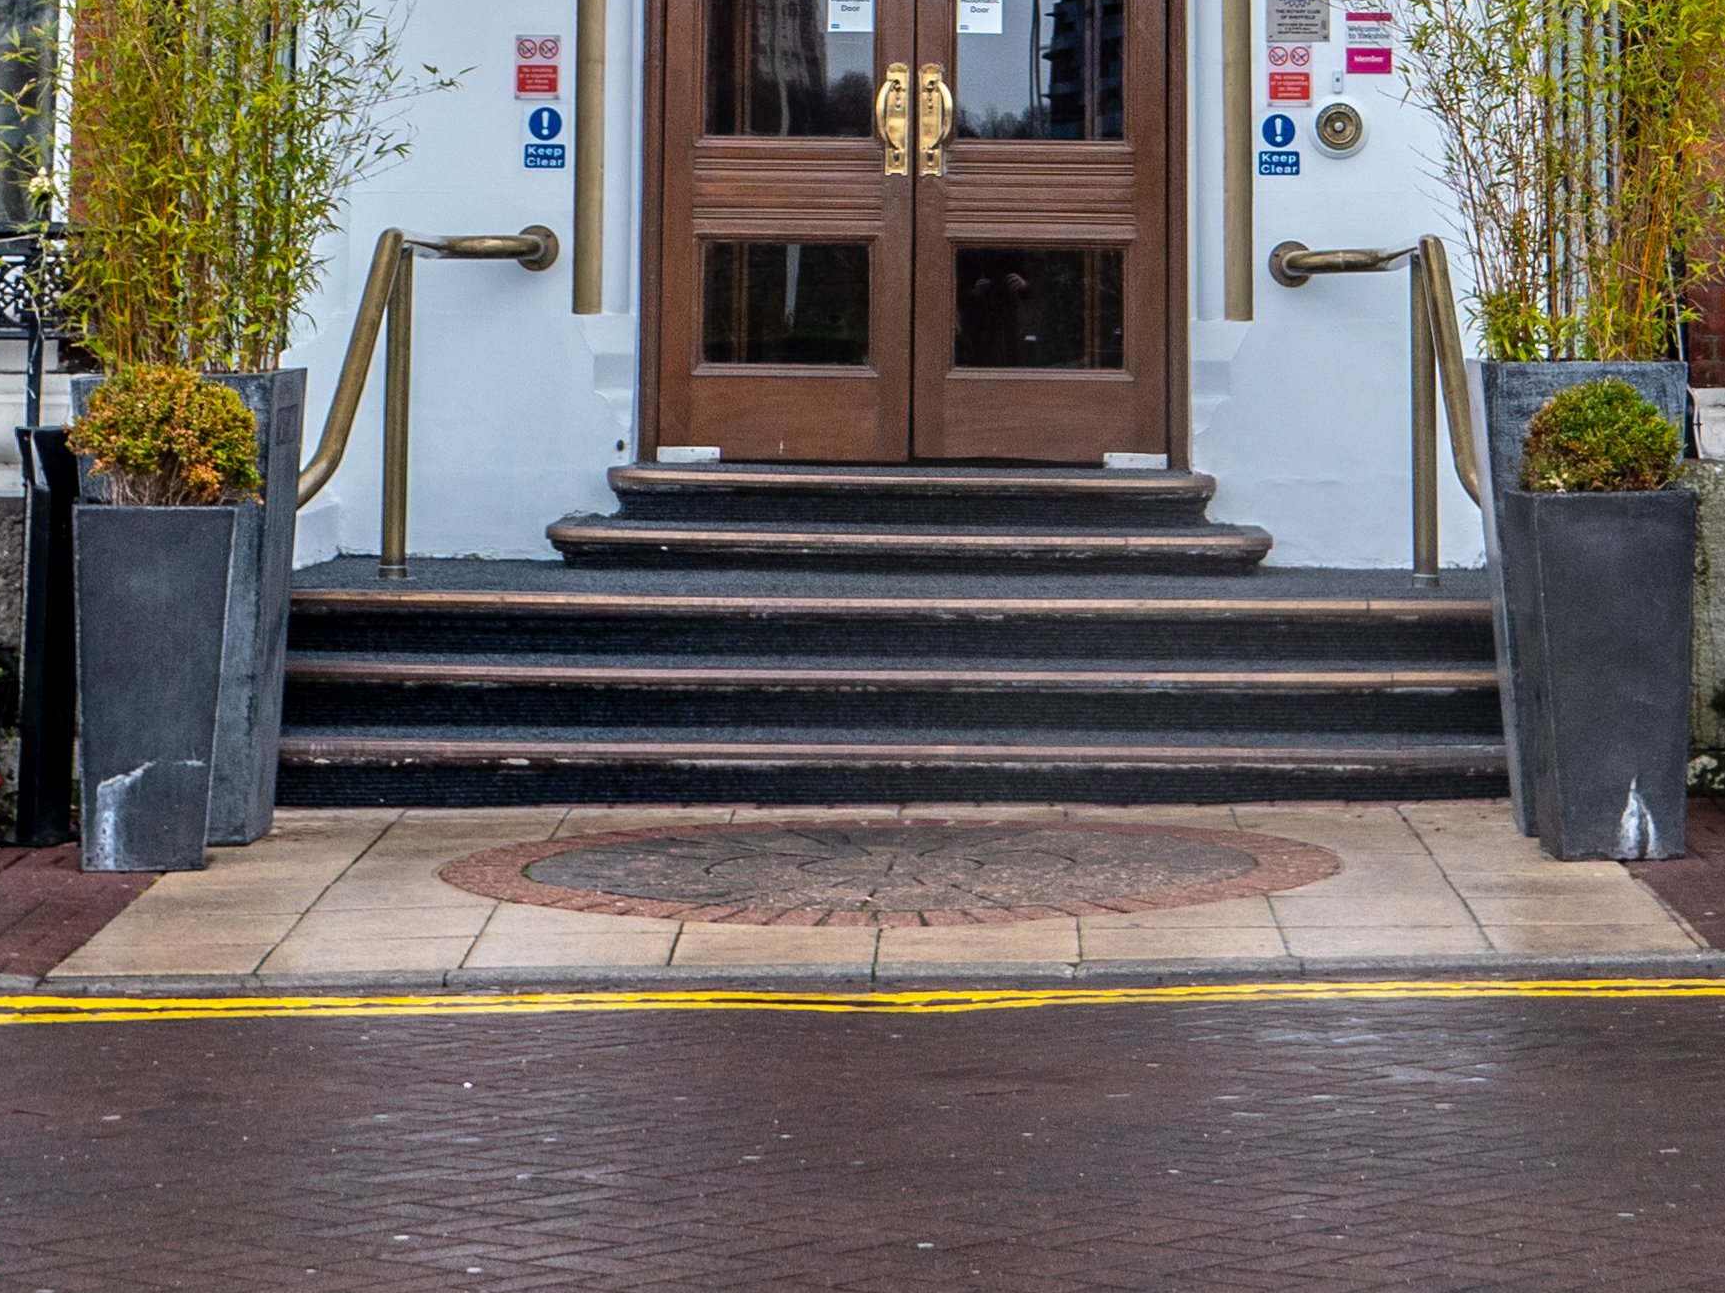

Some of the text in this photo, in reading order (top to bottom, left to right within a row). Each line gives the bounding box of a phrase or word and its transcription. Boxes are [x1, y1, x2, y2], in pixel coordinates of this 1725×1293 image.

[527, 146, 563, 156] Keep
[526, 157, 563, 166] Clear
[1261, 153, 1297, 164] Keep
[1261, 164, 1298, 173] Clear
